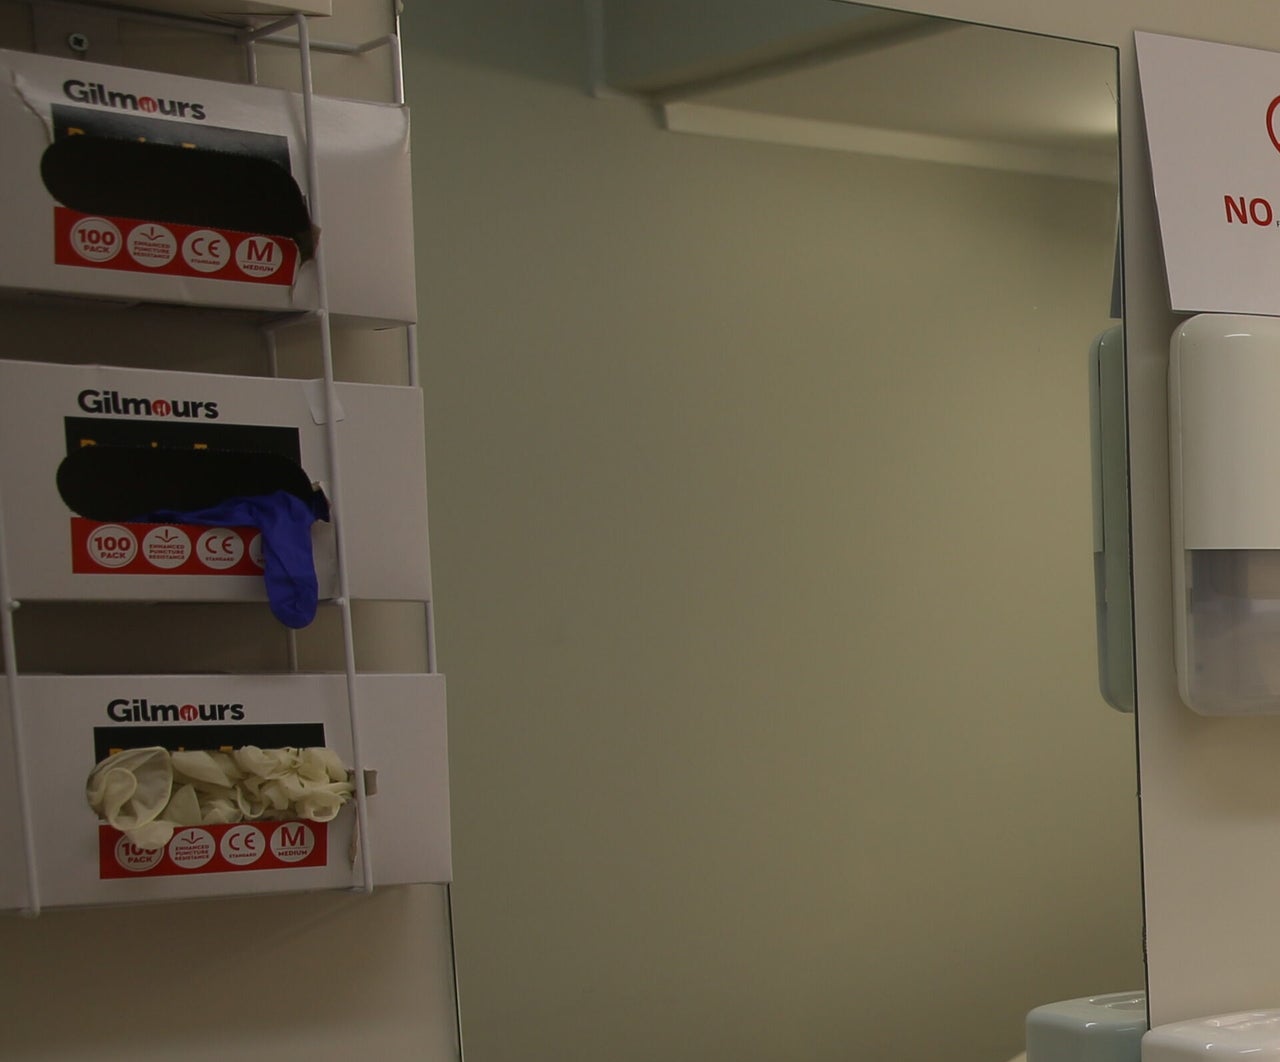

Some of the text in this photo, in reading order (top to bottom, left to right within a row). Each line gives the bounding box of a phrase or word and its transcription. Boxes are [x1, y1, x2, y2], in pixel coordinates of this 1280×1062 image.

[63, 79, 206, 120] Gilmours
[1223, 195, 1273, 226] NO
[78, 229, 115, 246] 100
[83, 244, 111, 253] PACK
[247, 239, 274, 262] M
[243, 264, 274, 272] MEDIUM
[77, 389, 219, 419] Gilmours
[94, 536, 131, 551] 100
[100, 551, 126, 559] PACK
[107, 698, 245, 722] Gilmours
[281, 826, 305, 847] M
